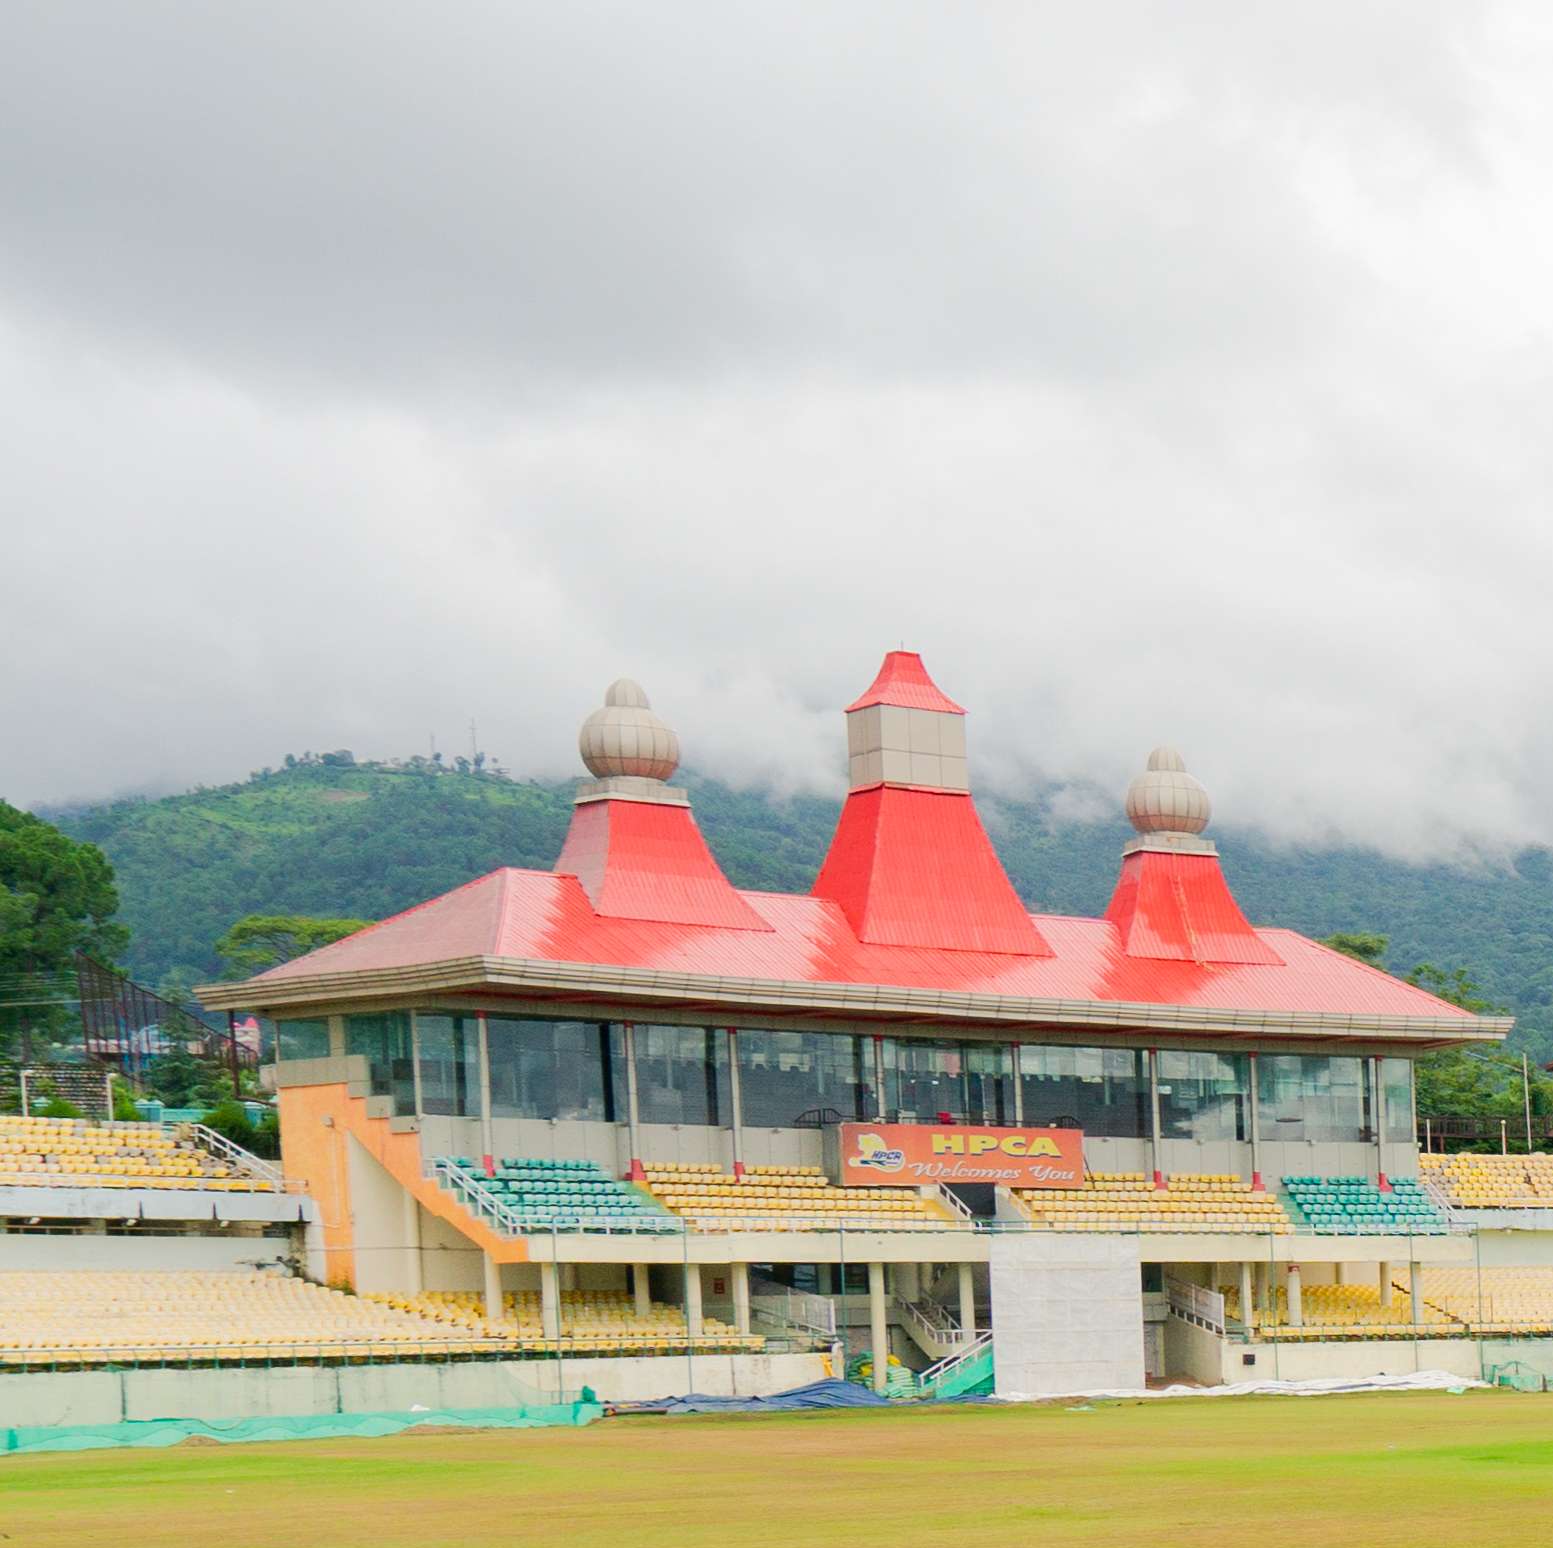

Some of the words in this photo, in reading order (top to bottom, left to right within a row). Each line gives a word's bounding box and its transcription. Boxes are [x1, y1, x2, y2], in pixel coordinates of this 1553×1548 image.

[871, 1150, 903, 1160] HPCA
[931, 1134, 1062, 1158] HPCA
[908, 1160, 1022, 1180] Welcomes
[1028, 1165, 1075, 1181] You
